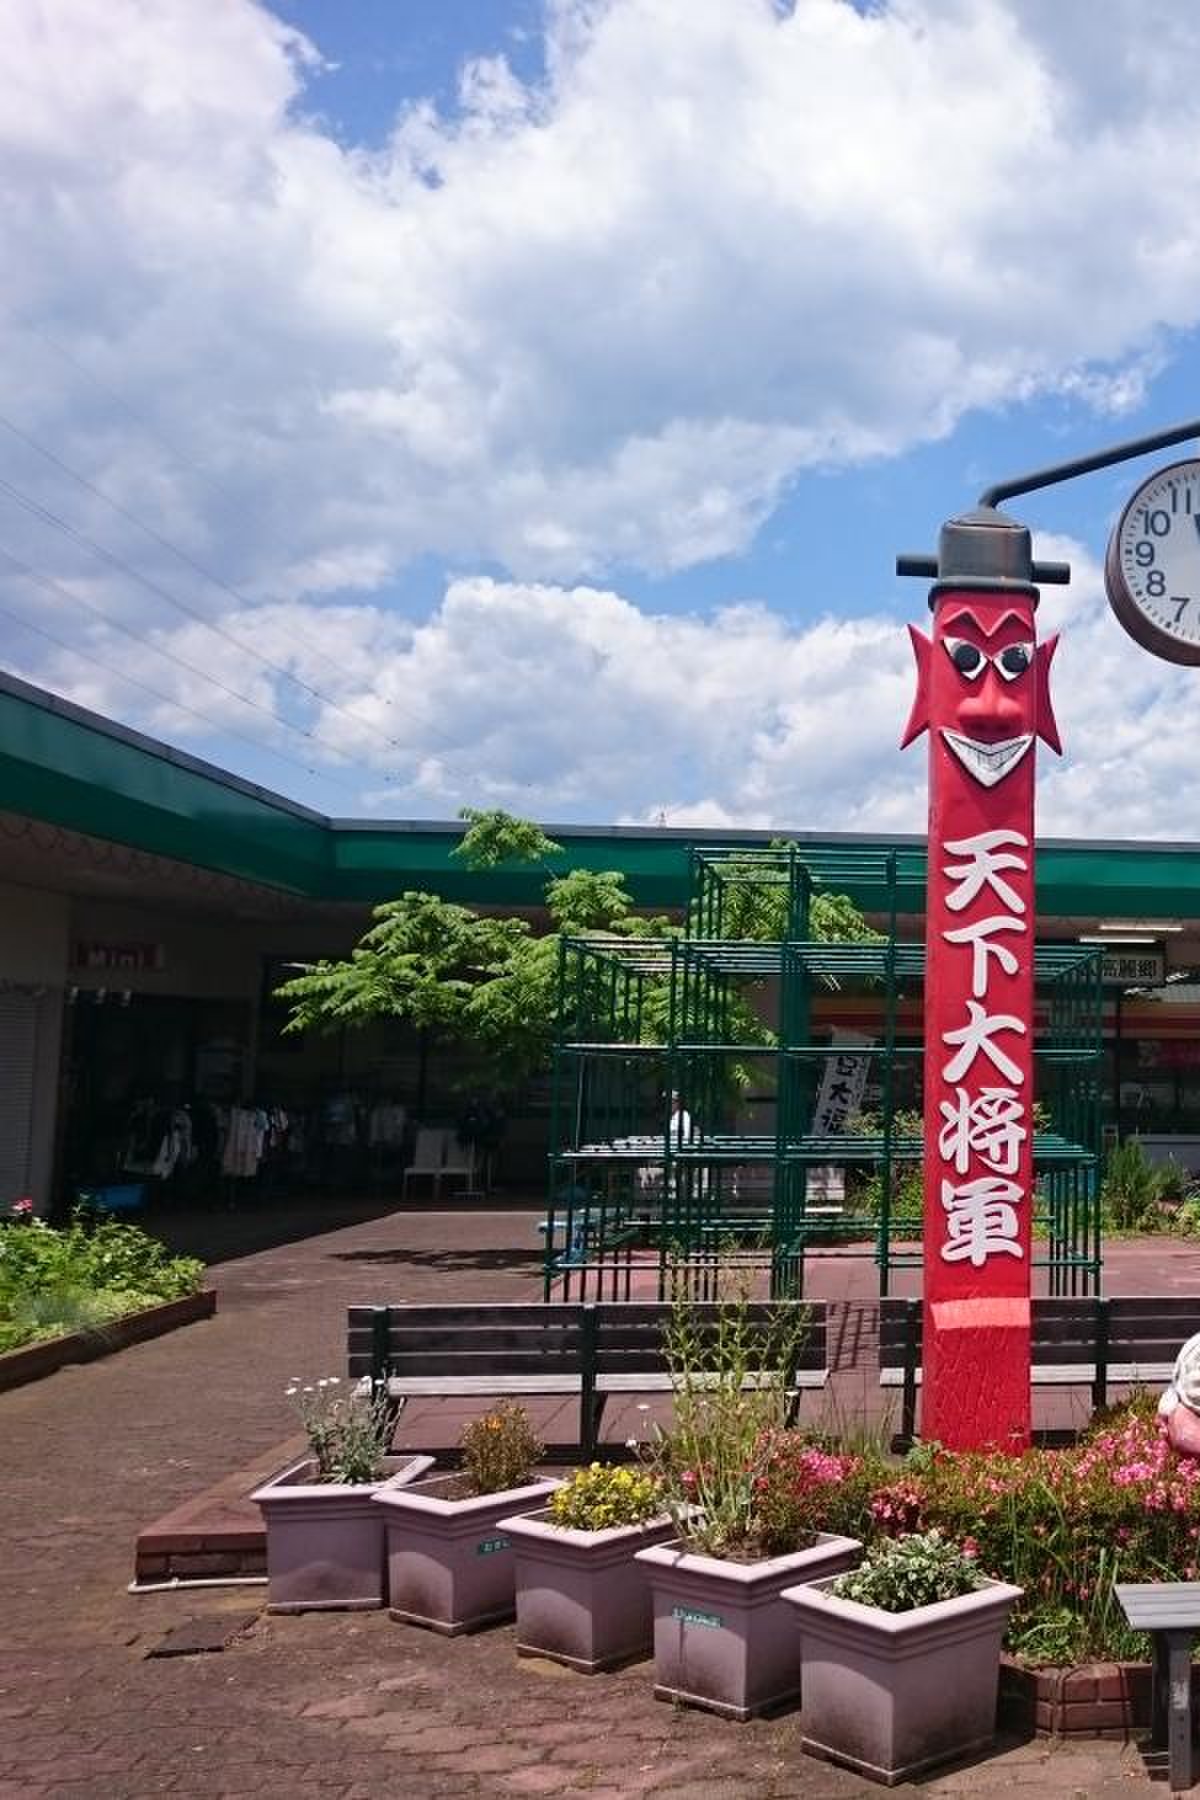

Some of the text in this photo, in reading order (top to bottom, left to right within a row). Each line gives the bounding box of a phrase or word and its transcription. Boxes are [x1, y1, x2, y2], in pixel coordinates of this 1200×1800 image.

[1172, 487, 1191, 514] 11
[1144, 509, 1170, 536] 10
[1135, 541, 1155, 567] 9
[1146, 571, 1166, 597] 8
[1170, 597, 1190, 623] 7
[939, 829, 1028, 1267] 天下大将軍
